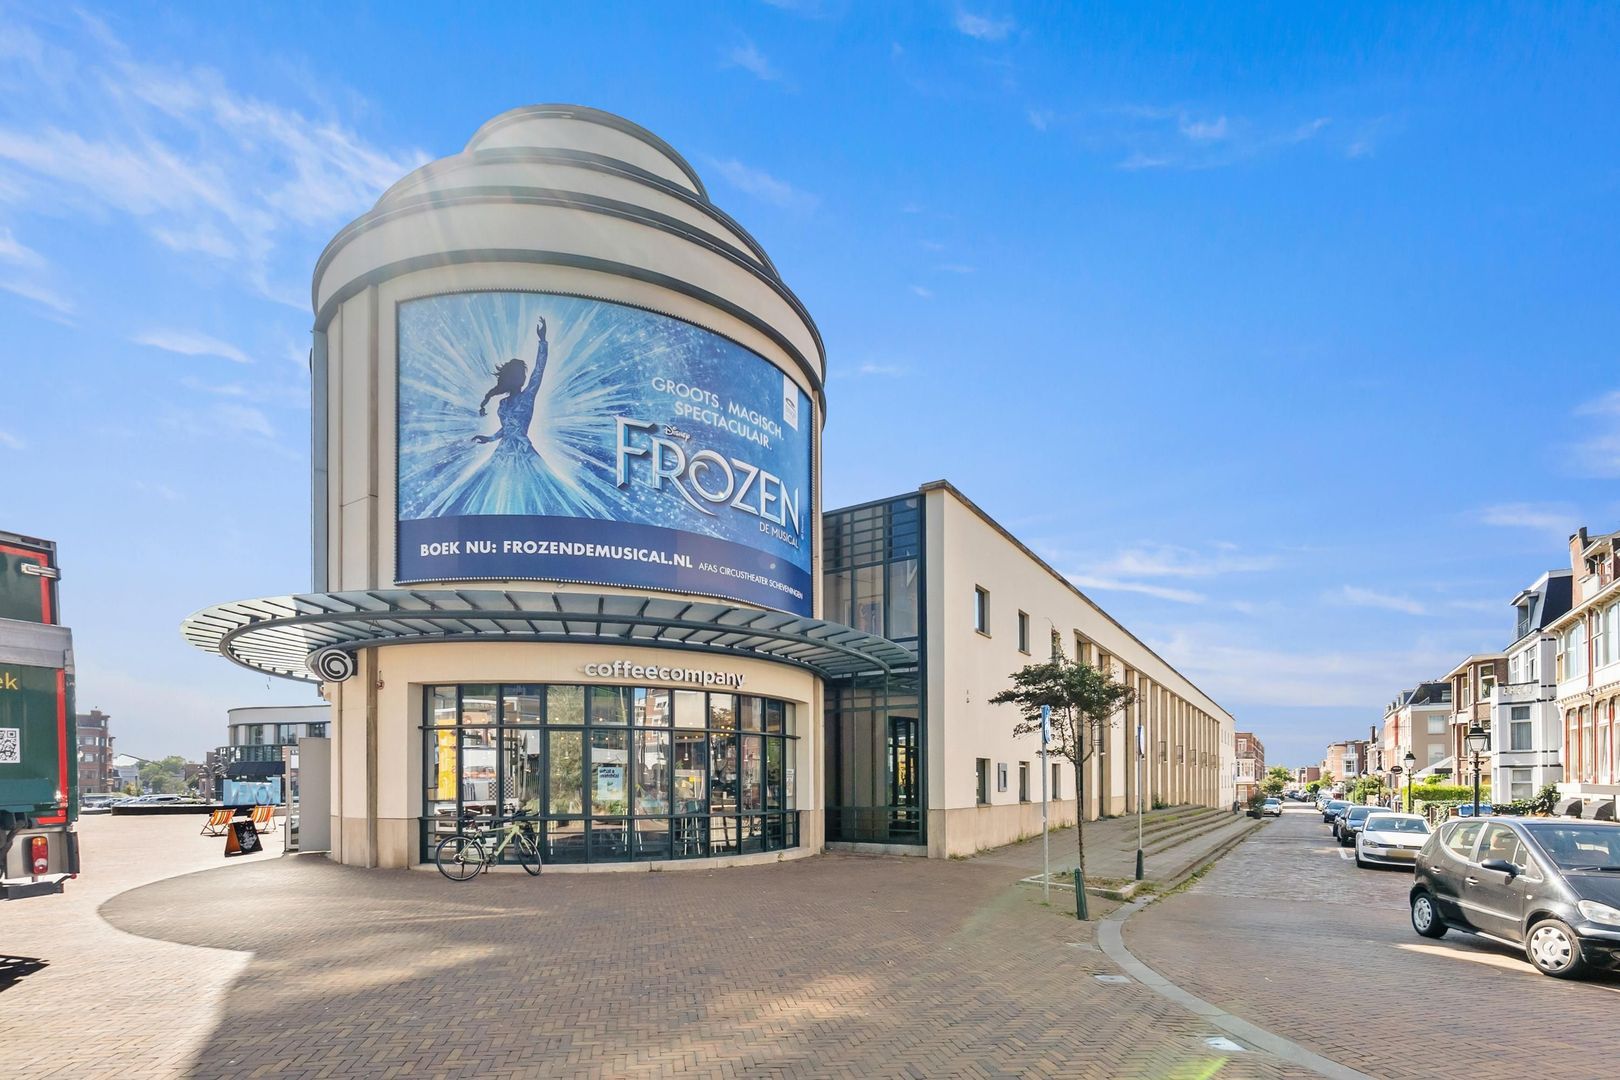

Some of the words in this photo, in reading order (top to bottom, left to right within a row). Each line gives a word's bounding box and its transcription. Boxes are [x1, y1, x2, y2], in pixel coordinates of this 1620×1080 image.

[652, 377, 723, 410] GROOTS.
[728, 401, 784, 440] MAGISCH.
[664, 424, 691, 442] Disney
[675, 401, 772, 450] SPECTACULAIR.
[614, 415, 799, 535] FROZEN
[760, 521, 769, 534] DE
[772, 526, 799, 549] MUSICAL
[420, 542, 461, 557] BOEK
[466, 540, 497, 554] NU:
[503, 540, 693, 568] FROZENDEMUSICAL.NL
[698, 562, 718, 574] AFAS
[719, 566, 768, 585] CIRCUSTHEATER
[769, 579, 803, 599] SCHEVENINGEN
[584, 660, 746, 689] coffeecompany
